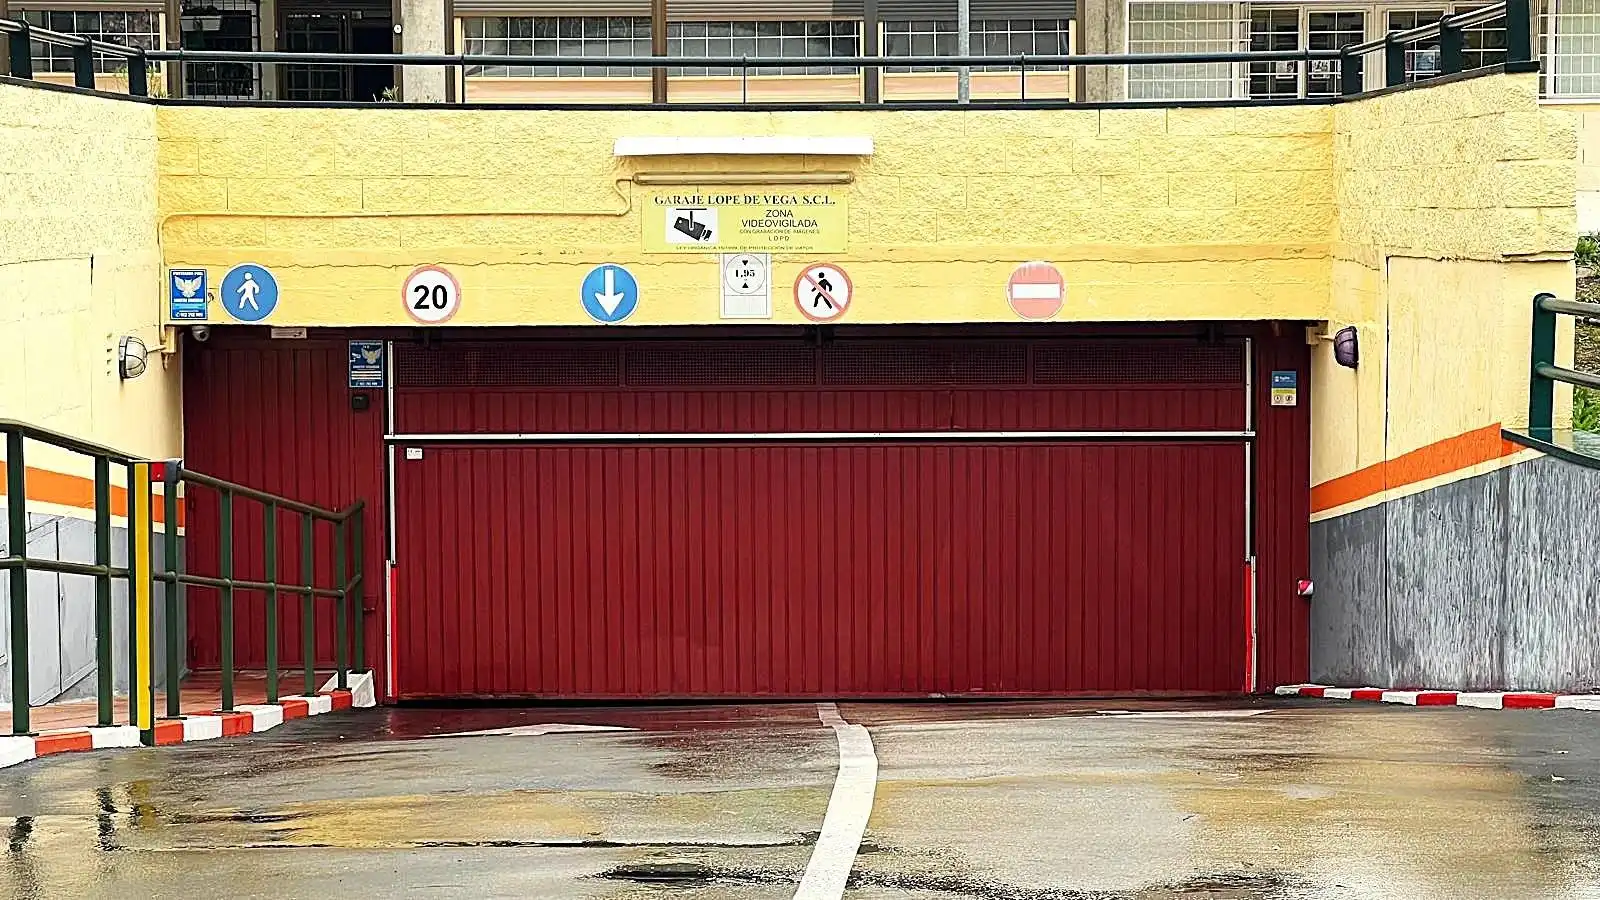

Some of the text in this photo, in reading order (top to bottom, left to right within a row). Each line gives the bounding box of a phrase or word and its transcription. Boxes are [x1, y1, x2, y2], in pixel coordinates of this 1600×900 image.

[654, 195, 836, 205] GARAJE LOPE DE VEGA S.C.L.
[766, 209, 794, 218] ZONA
[741, 219, 818, 228] VIDEOVIGILADA
[413, 284, 448, 310] 20
